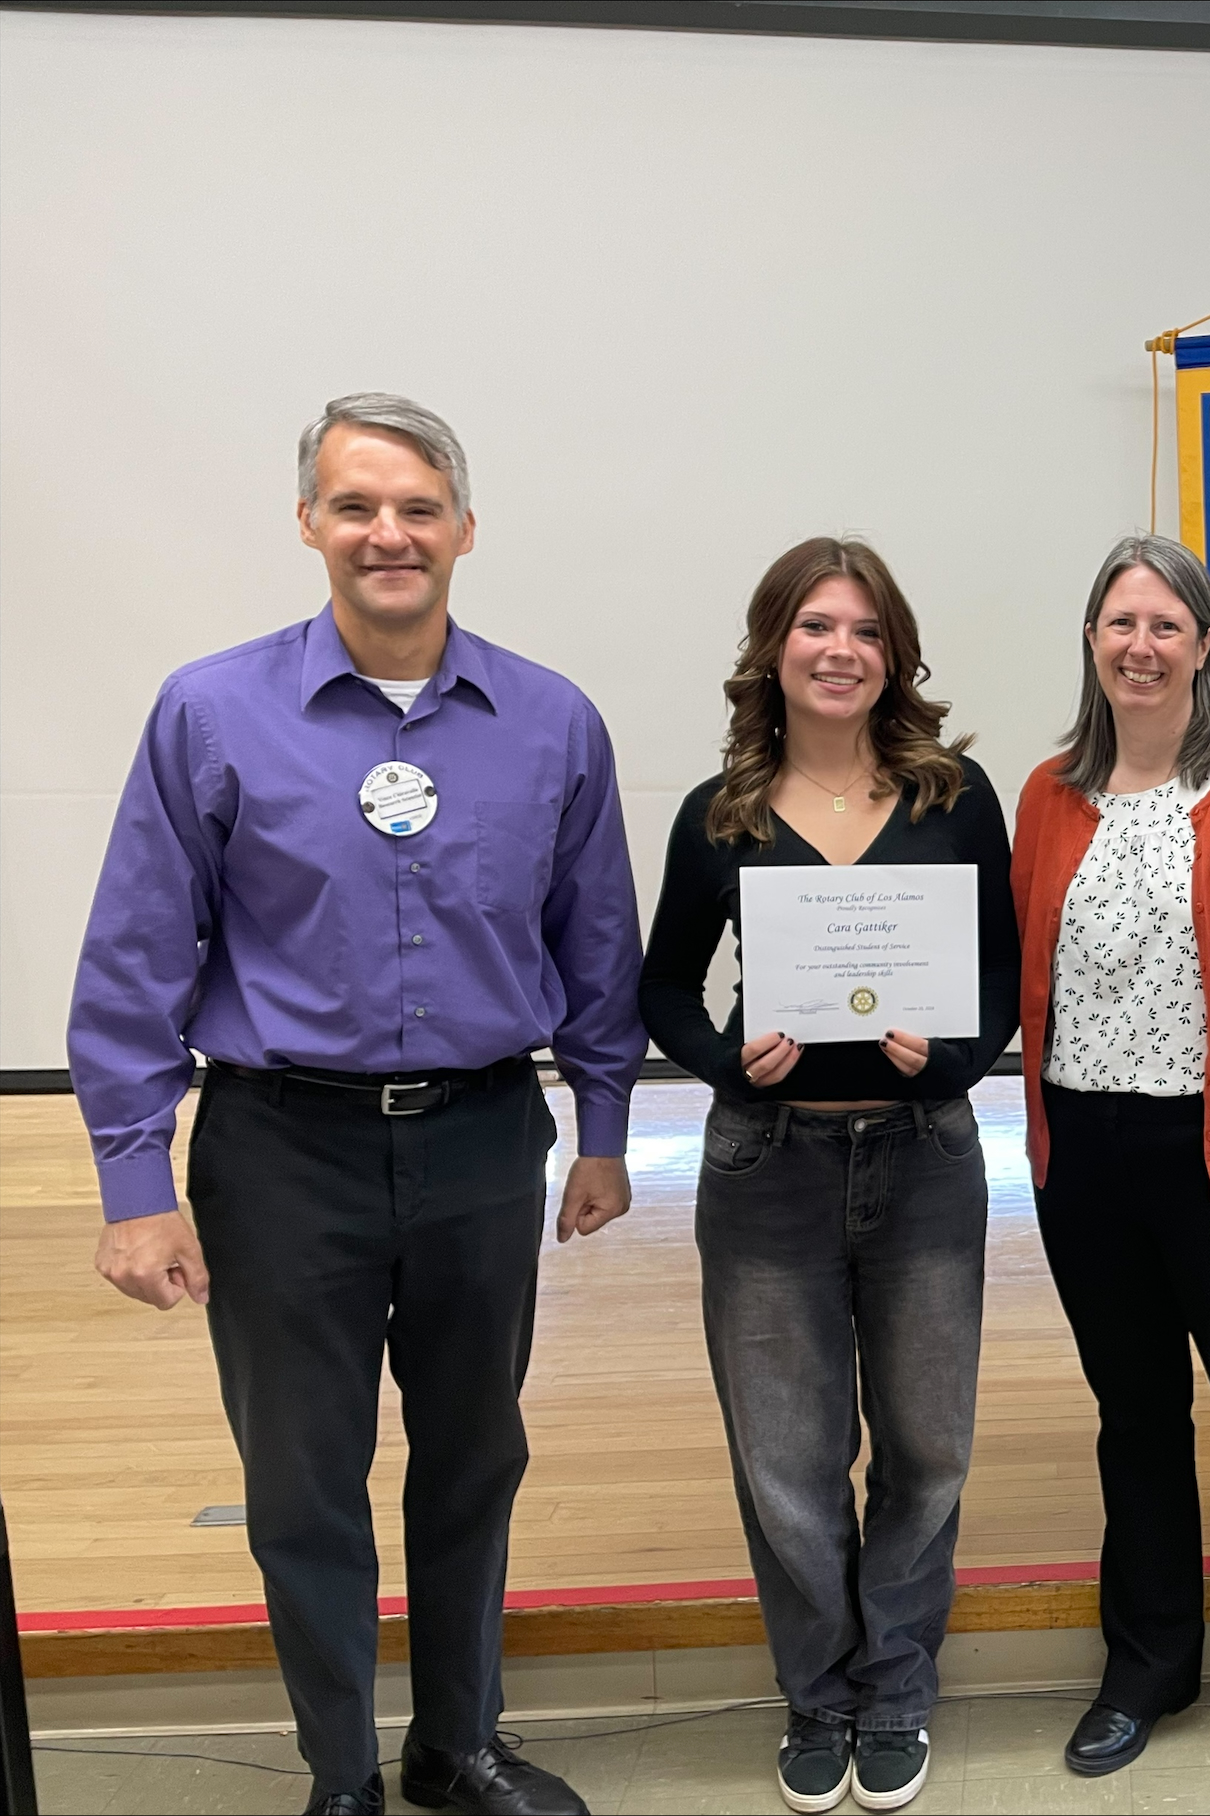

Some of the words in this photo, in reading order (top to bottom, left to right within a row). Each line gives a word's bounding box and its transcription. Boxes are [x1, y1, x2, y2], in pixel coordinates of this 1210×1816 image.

[397, 764, 424, 779] CLUB
[798, 893, 813, 903] The
[815, 894, 844, 905] Rotary
[845, 892, 865, 903] Club
[866, 892, 876, 904] of
[877, 892, 892, 902] Los
[893, 892, 924, 903] Alamos
[827, 922, 851, 934] Cara
[854, 920, 898, 936] Gattiker
[813, 943, 855, 952] Distinguished
[856, 943, 880, 951] Student
[881, 942, 890, 952] of
[807, 964, 821, 972] your
[822, 962, 858, 970] outstanding
[859, 961, 892, 969] community
[893, 960, 929, 968] involvement
[834, 970, 845, 978] and
[846, 970, 877, 979] leadership
